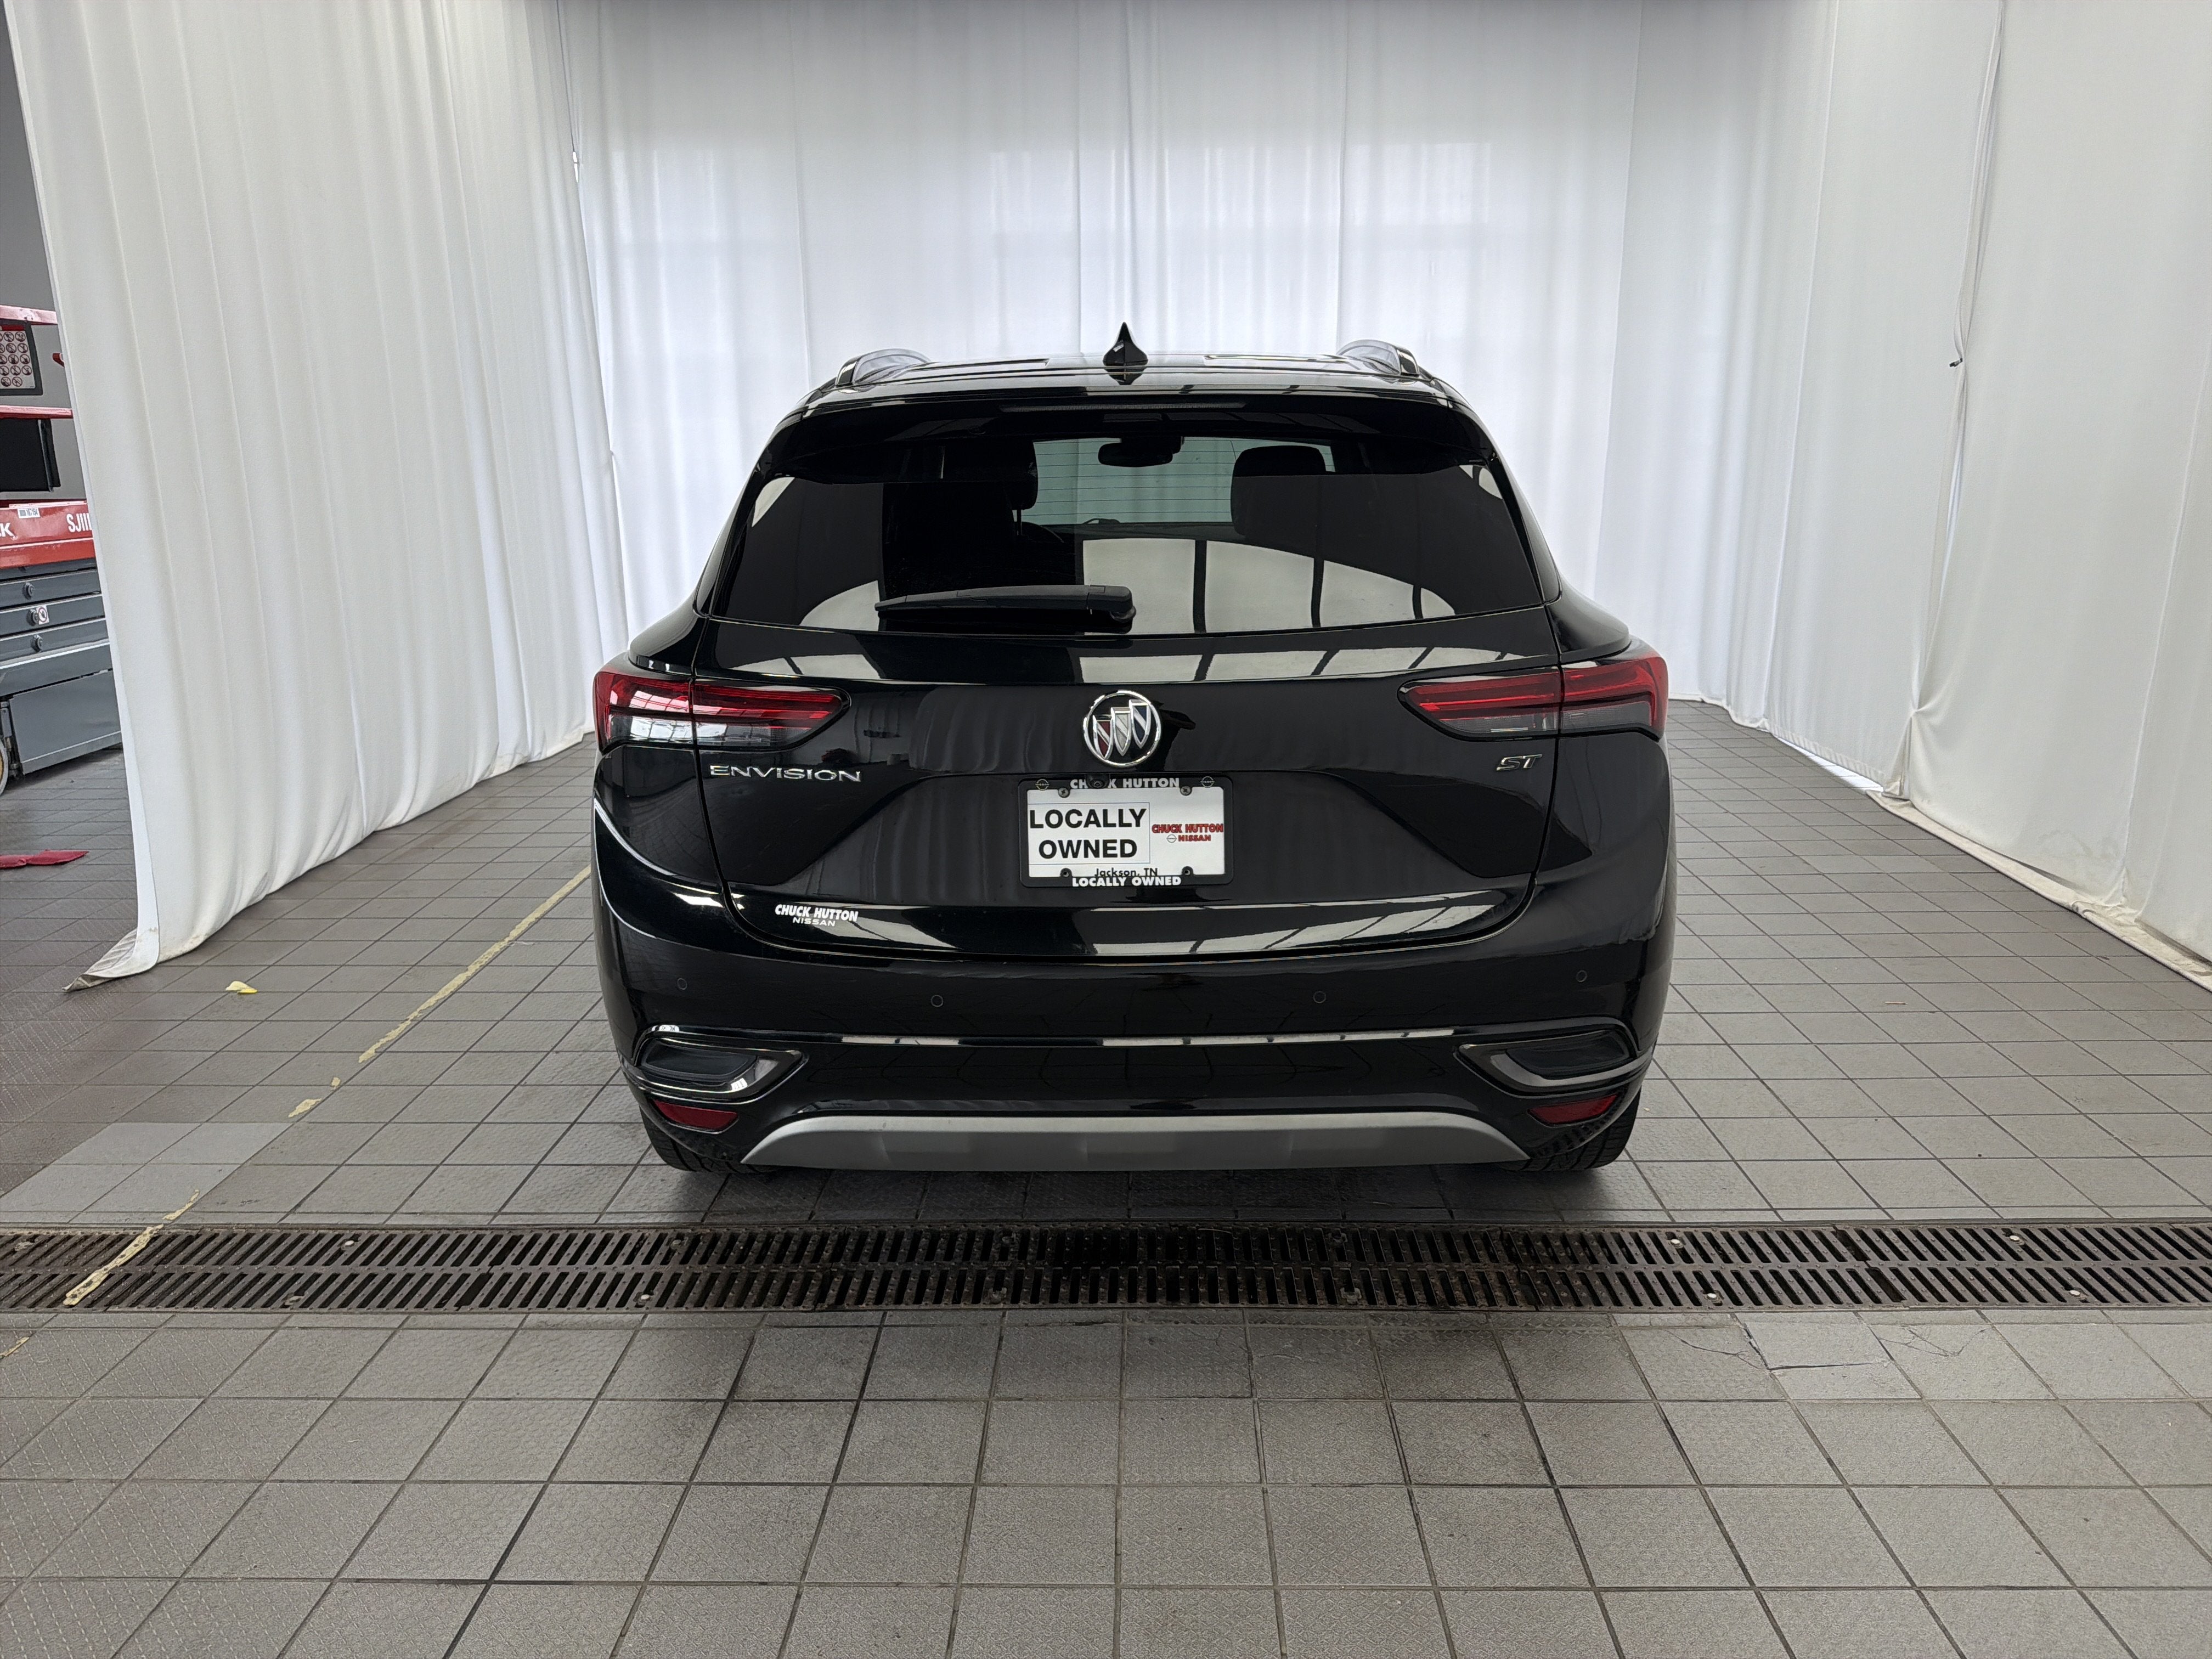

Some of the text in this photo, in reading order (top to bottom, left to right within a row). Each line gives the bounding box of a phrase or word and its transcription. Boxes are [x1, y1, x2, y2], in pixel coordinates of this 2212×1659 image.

[1496, 754, 1543, 771] ST
[710, 765, 861, 782] ENVISION
[1070, 777, 1180, 789] CHK HUTTON
[1029, 808, 1147, 829] LOCALLY
[1151, 823, 1224, 833] CHUCK HUTTON
[1039, 839, 1137, 859] OWNED
[1094, 867, 1158, 877] Jackson, TN
[1072, 876, 1182, 887] LOCALLY OWNED
[775, 904, 859, 922] CHUCK HUTTON
[792, 917, 836, 927] NISSAN
